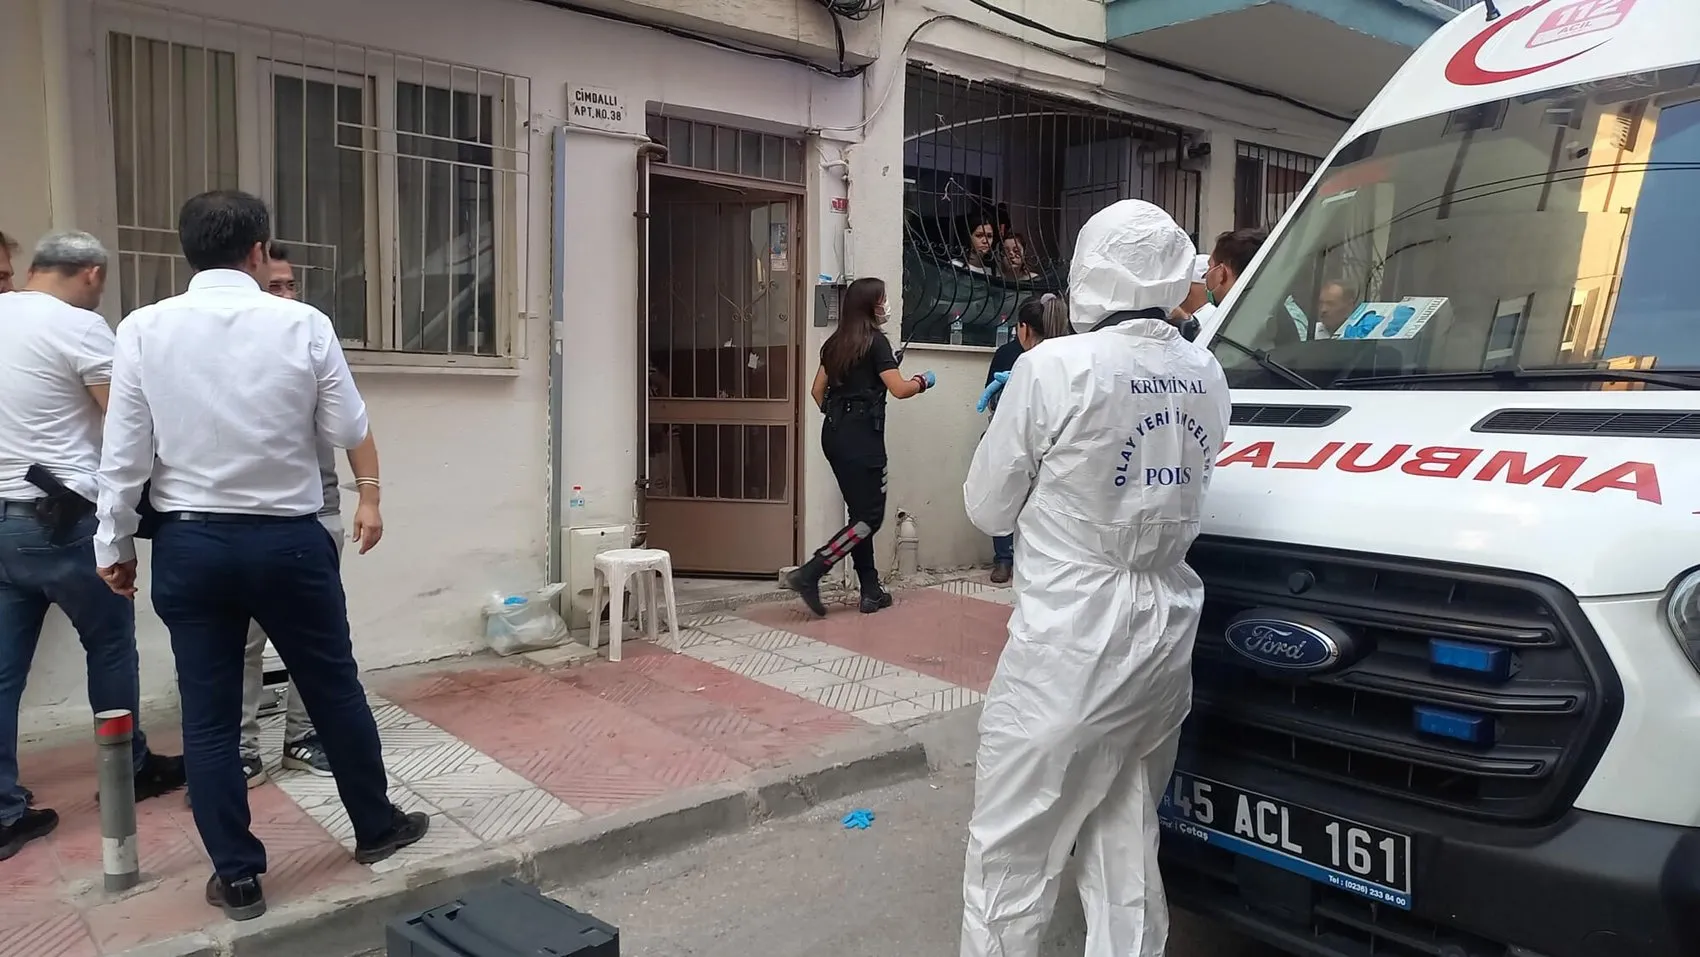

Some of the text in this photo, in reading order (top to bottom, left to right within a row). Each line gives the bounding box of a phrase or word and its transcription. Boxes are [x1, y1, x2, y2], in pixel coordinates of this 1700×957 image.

[1555, 0, 1620, 26] 112
[574, 105, 622, 121] APT.NO.38
[1131, 376, 1206, 395] KRİMİNAL
[1114, 436, 1137, 487] OLAY
[1136, 407, 1170, 437] YERİ
[1244, 625, 1307, 660] Ford
[1173, 775, 1395, 883] 45 ACL 161
[1178, 822, 1209, 842] Çetaş
[1328, 874, 1340, 885] Tel
[1345, 880, 1368, 894] (0236)
[1369, 888, 1384, 899] 233
[1384, 893, 1395, 902] 84
[1395, 896, 1406, 906] 00
